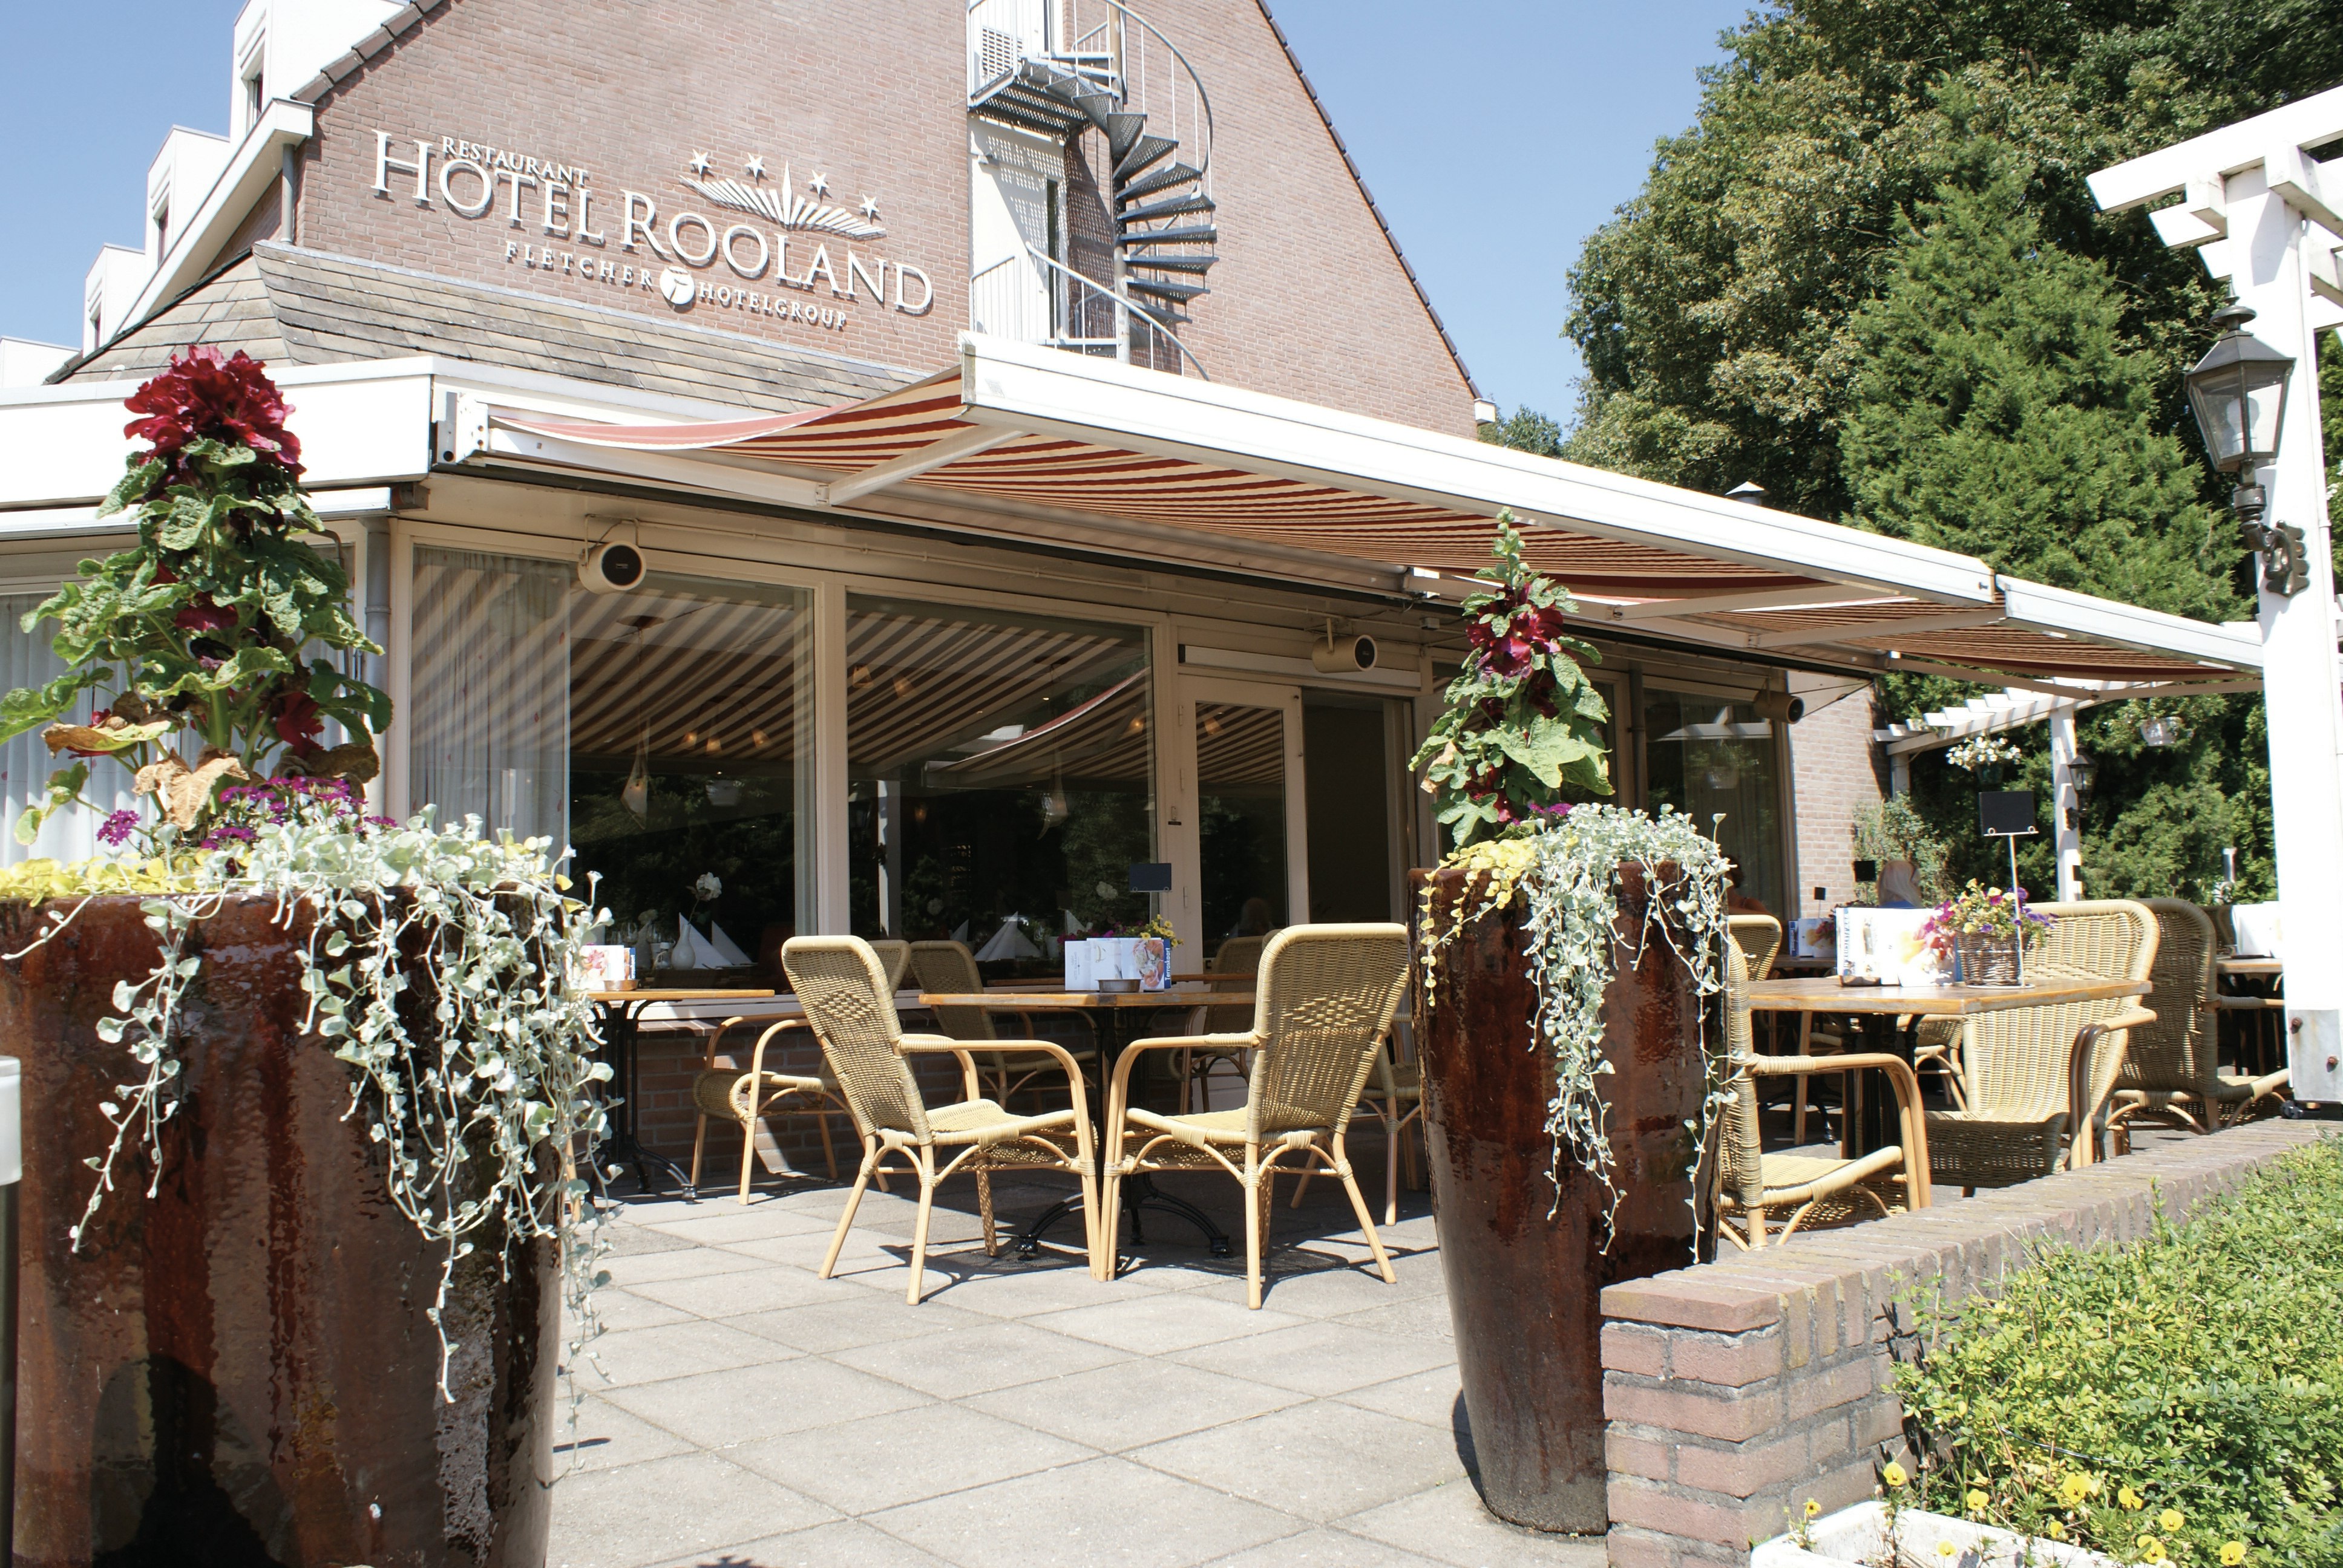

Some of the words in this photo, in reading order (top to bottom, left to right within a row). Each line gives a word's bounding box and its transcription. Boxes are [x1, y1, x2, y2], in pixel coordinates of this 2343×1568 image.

[442, 135, 588, 186] RESTAURANT
[370, 129, 604, 240] HOTEL
[620, 188, 932, 310] ROOLAND
[505, 241, 652, 287] FLETCHER
[698, 281, 847, 329] HOTELGROUP
